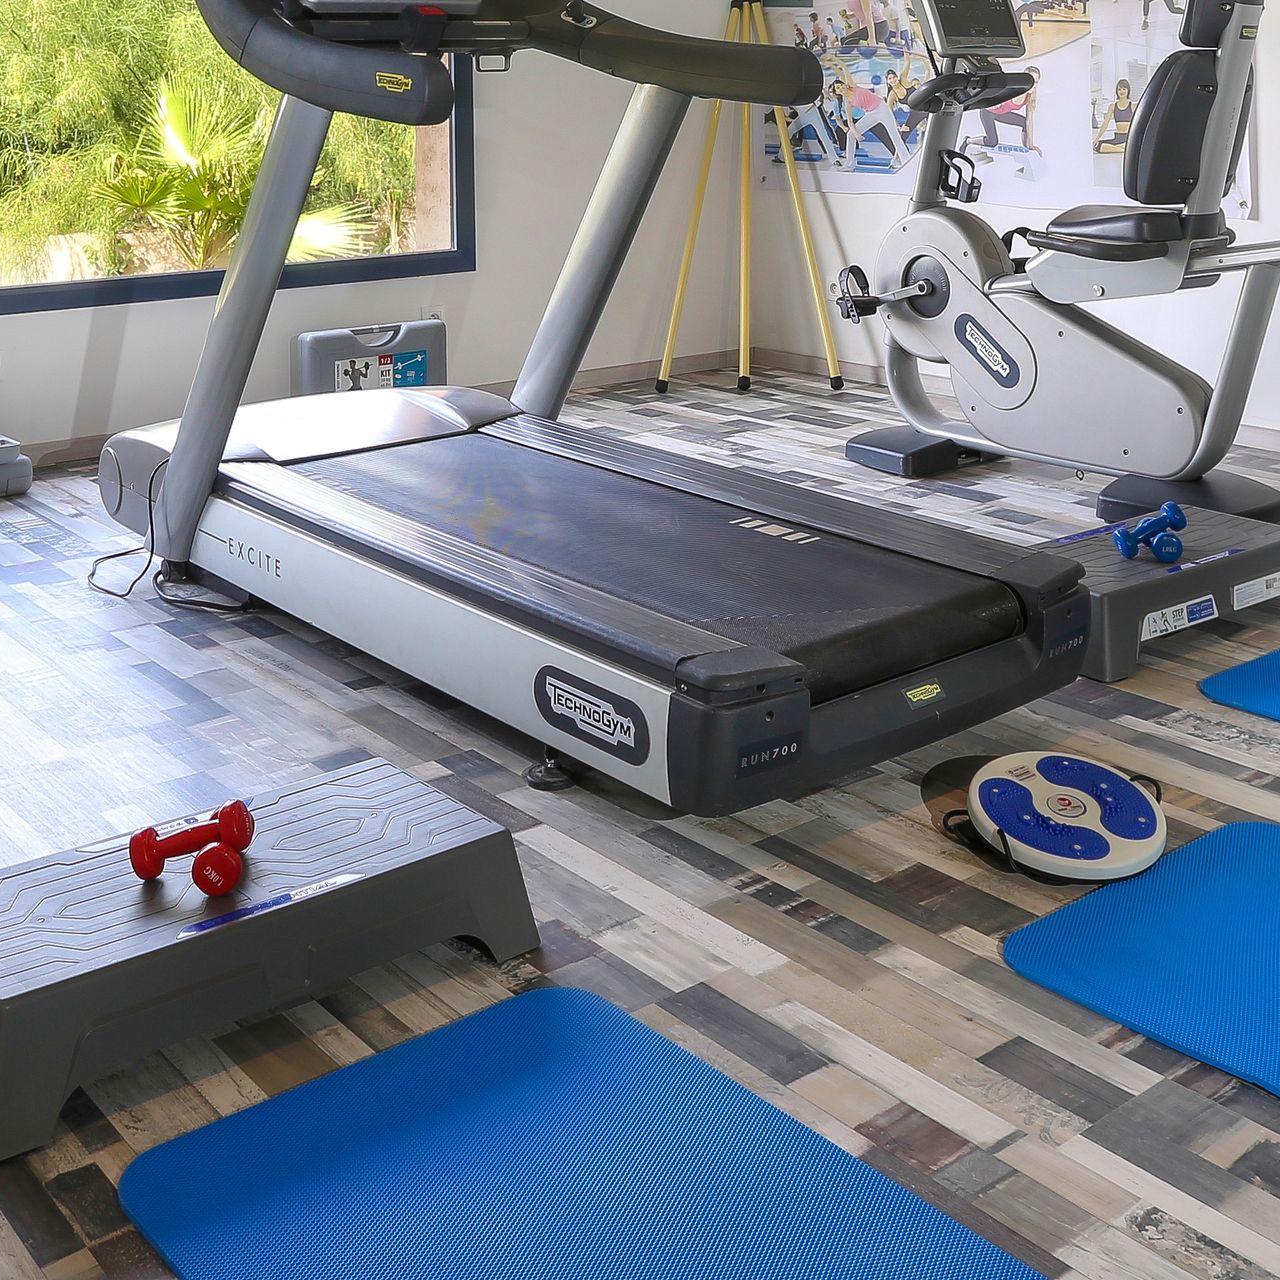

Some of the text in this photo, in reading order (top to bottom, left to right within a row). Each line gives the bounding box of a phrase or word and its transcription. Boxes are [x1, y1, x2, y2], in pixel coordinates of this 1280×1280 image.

[968, 324, 1008, 373] TECHNOGYM
[380, 369, 391, 377] KIT
[229, 538, 281, 578] EXCITE
[1171, 607, 1185, 619] STEP
[547, 682, 632, 738] TECHNOGYM
[203, 865, 225, 887] 1.0KG
